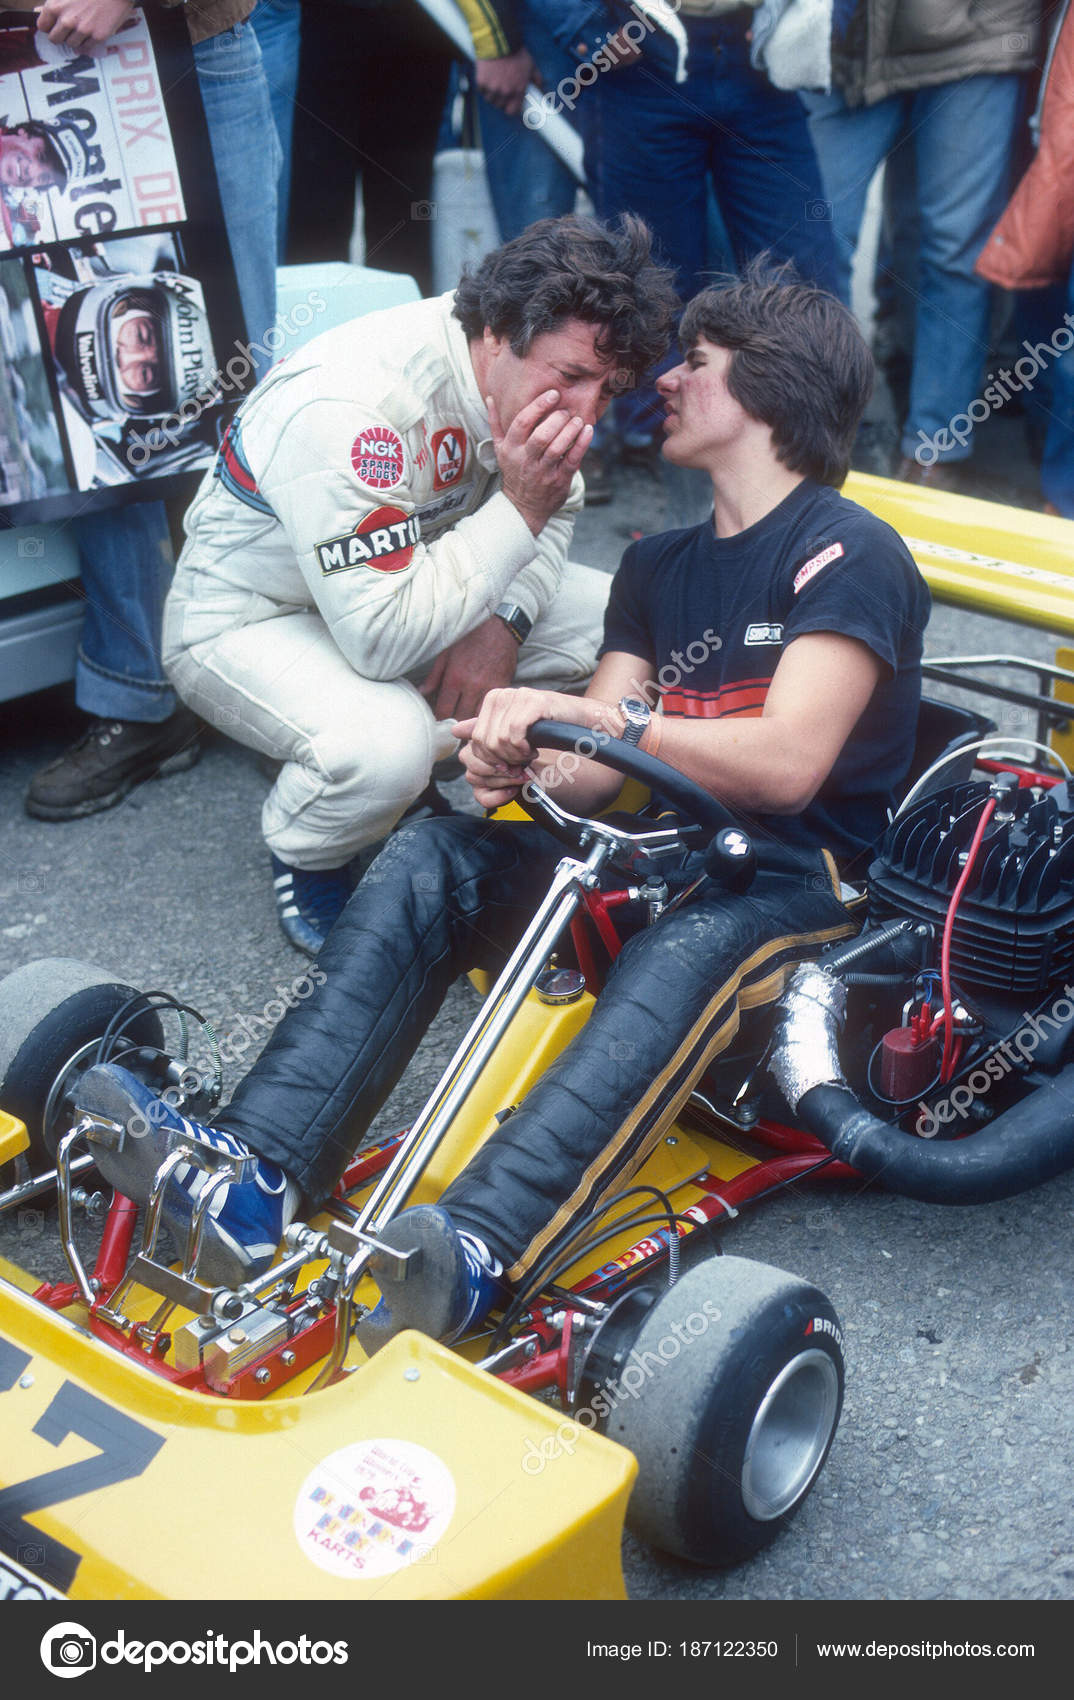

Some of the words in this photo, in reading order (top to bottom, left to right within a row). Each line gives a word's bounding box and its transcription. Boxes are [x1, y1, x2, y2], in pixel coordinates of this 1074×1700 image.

[107, 41, 167, 148] PRIX
[41, 54, 122, 234] Monte
[133, 171, 182, 226] DE
[78, 334, 99, 400] Valvoline
[360, 439, 399, 459] NGK
[361, 459, 397, 471] SPARK
[361, 468, 397, 481] PLUGS
[308, 1529, 366, 1569] KARTS
